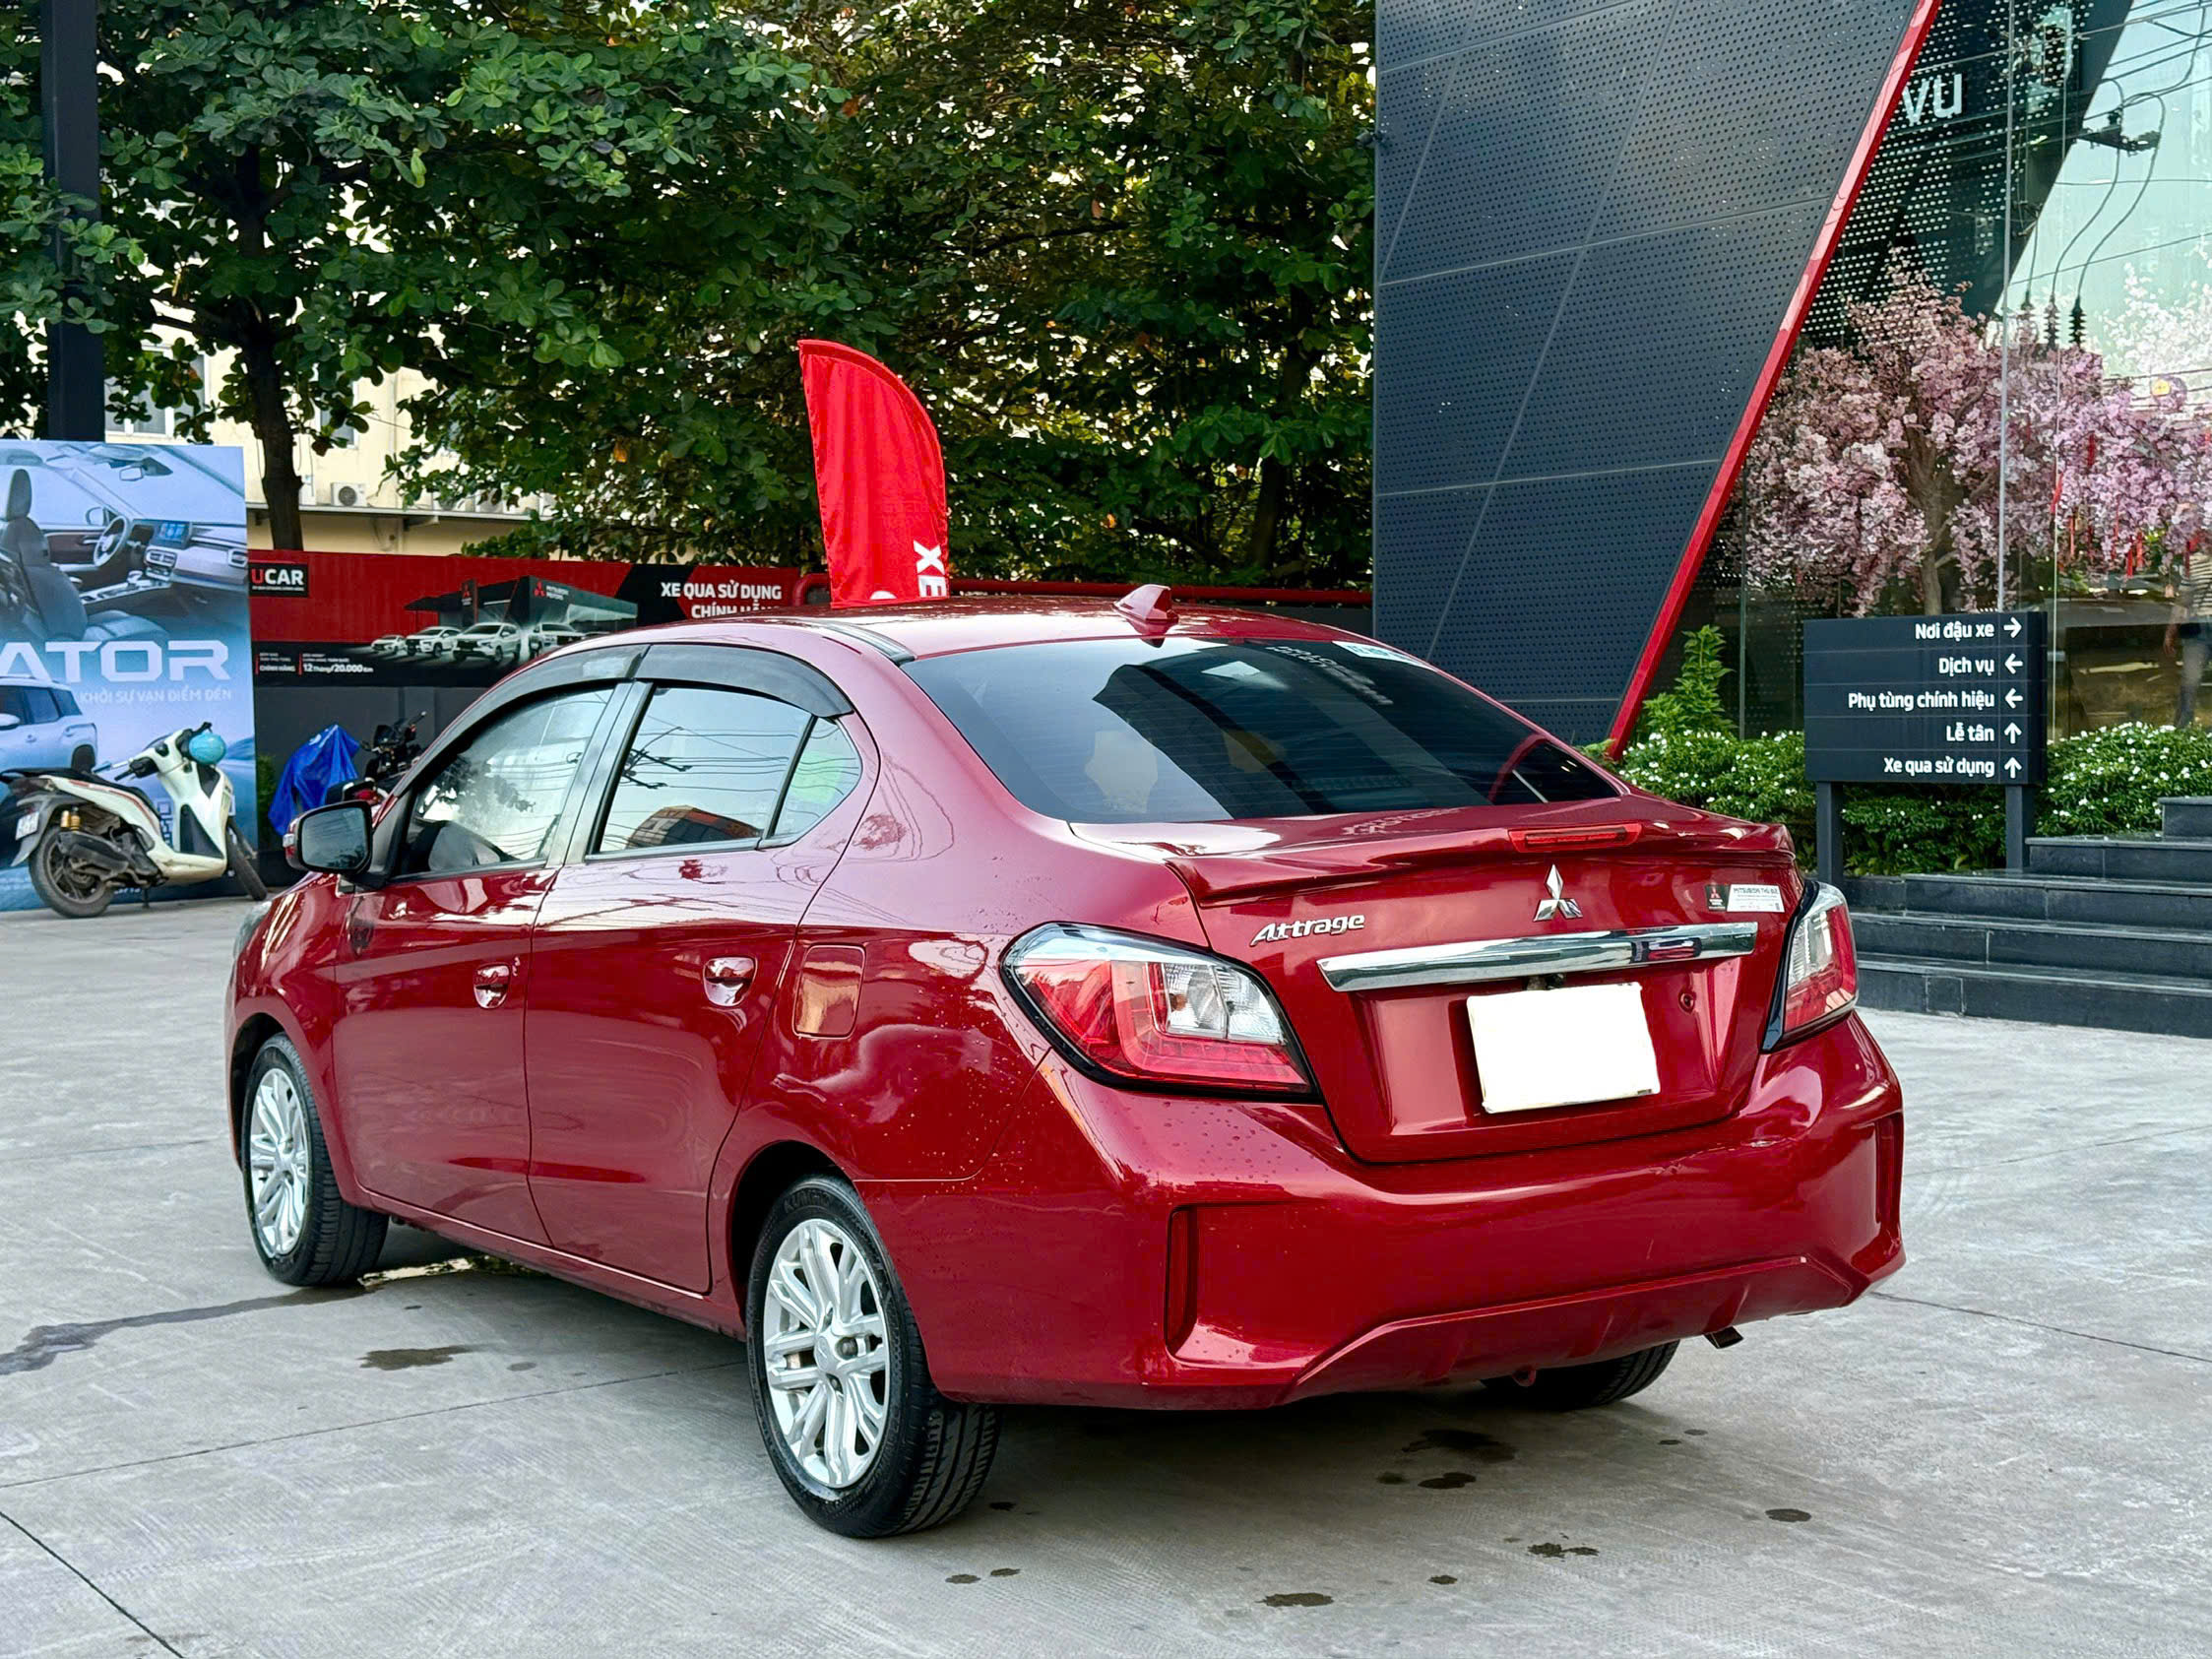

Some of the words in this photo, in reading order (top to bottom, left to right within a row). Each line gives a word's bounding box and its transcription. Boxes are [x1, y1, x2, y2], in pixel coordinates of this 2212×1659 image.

[251, 568, 304, 586] UCAR
[661, 582, 681, 598] XE
[683, 582, 716, 600] QUA
[718, 579, 739, 600] SỬ
[740, 584, 783, 603] DỤNG
[1916, 623, 1940, 640] Nơi
[1943, 620, 1972, 642] đậu
[1975, 623, 1994, 638] xe
[1938, 657, 1972, 677] Dịch
[1975, 659, 1994, 676] vụ
[1848, 692, 1875, 711] Phụ
[1879, 691, 1914, 711] tùng
[1917, 690, 1958, 708] chính
[1962, 689, 1994, 711] hiệu
[1946, 722, 1965, 741] Lễ
[1968, 724, 1994, 741] tân
[1883, 757, 1902, 773] Xe
[1905, 759, 1932, 777] qua
[1935, 755, 1955, 773] sử
[1956, 757, 1995, 778] dụng
[1250, 915, 1365, 947] Attrage
